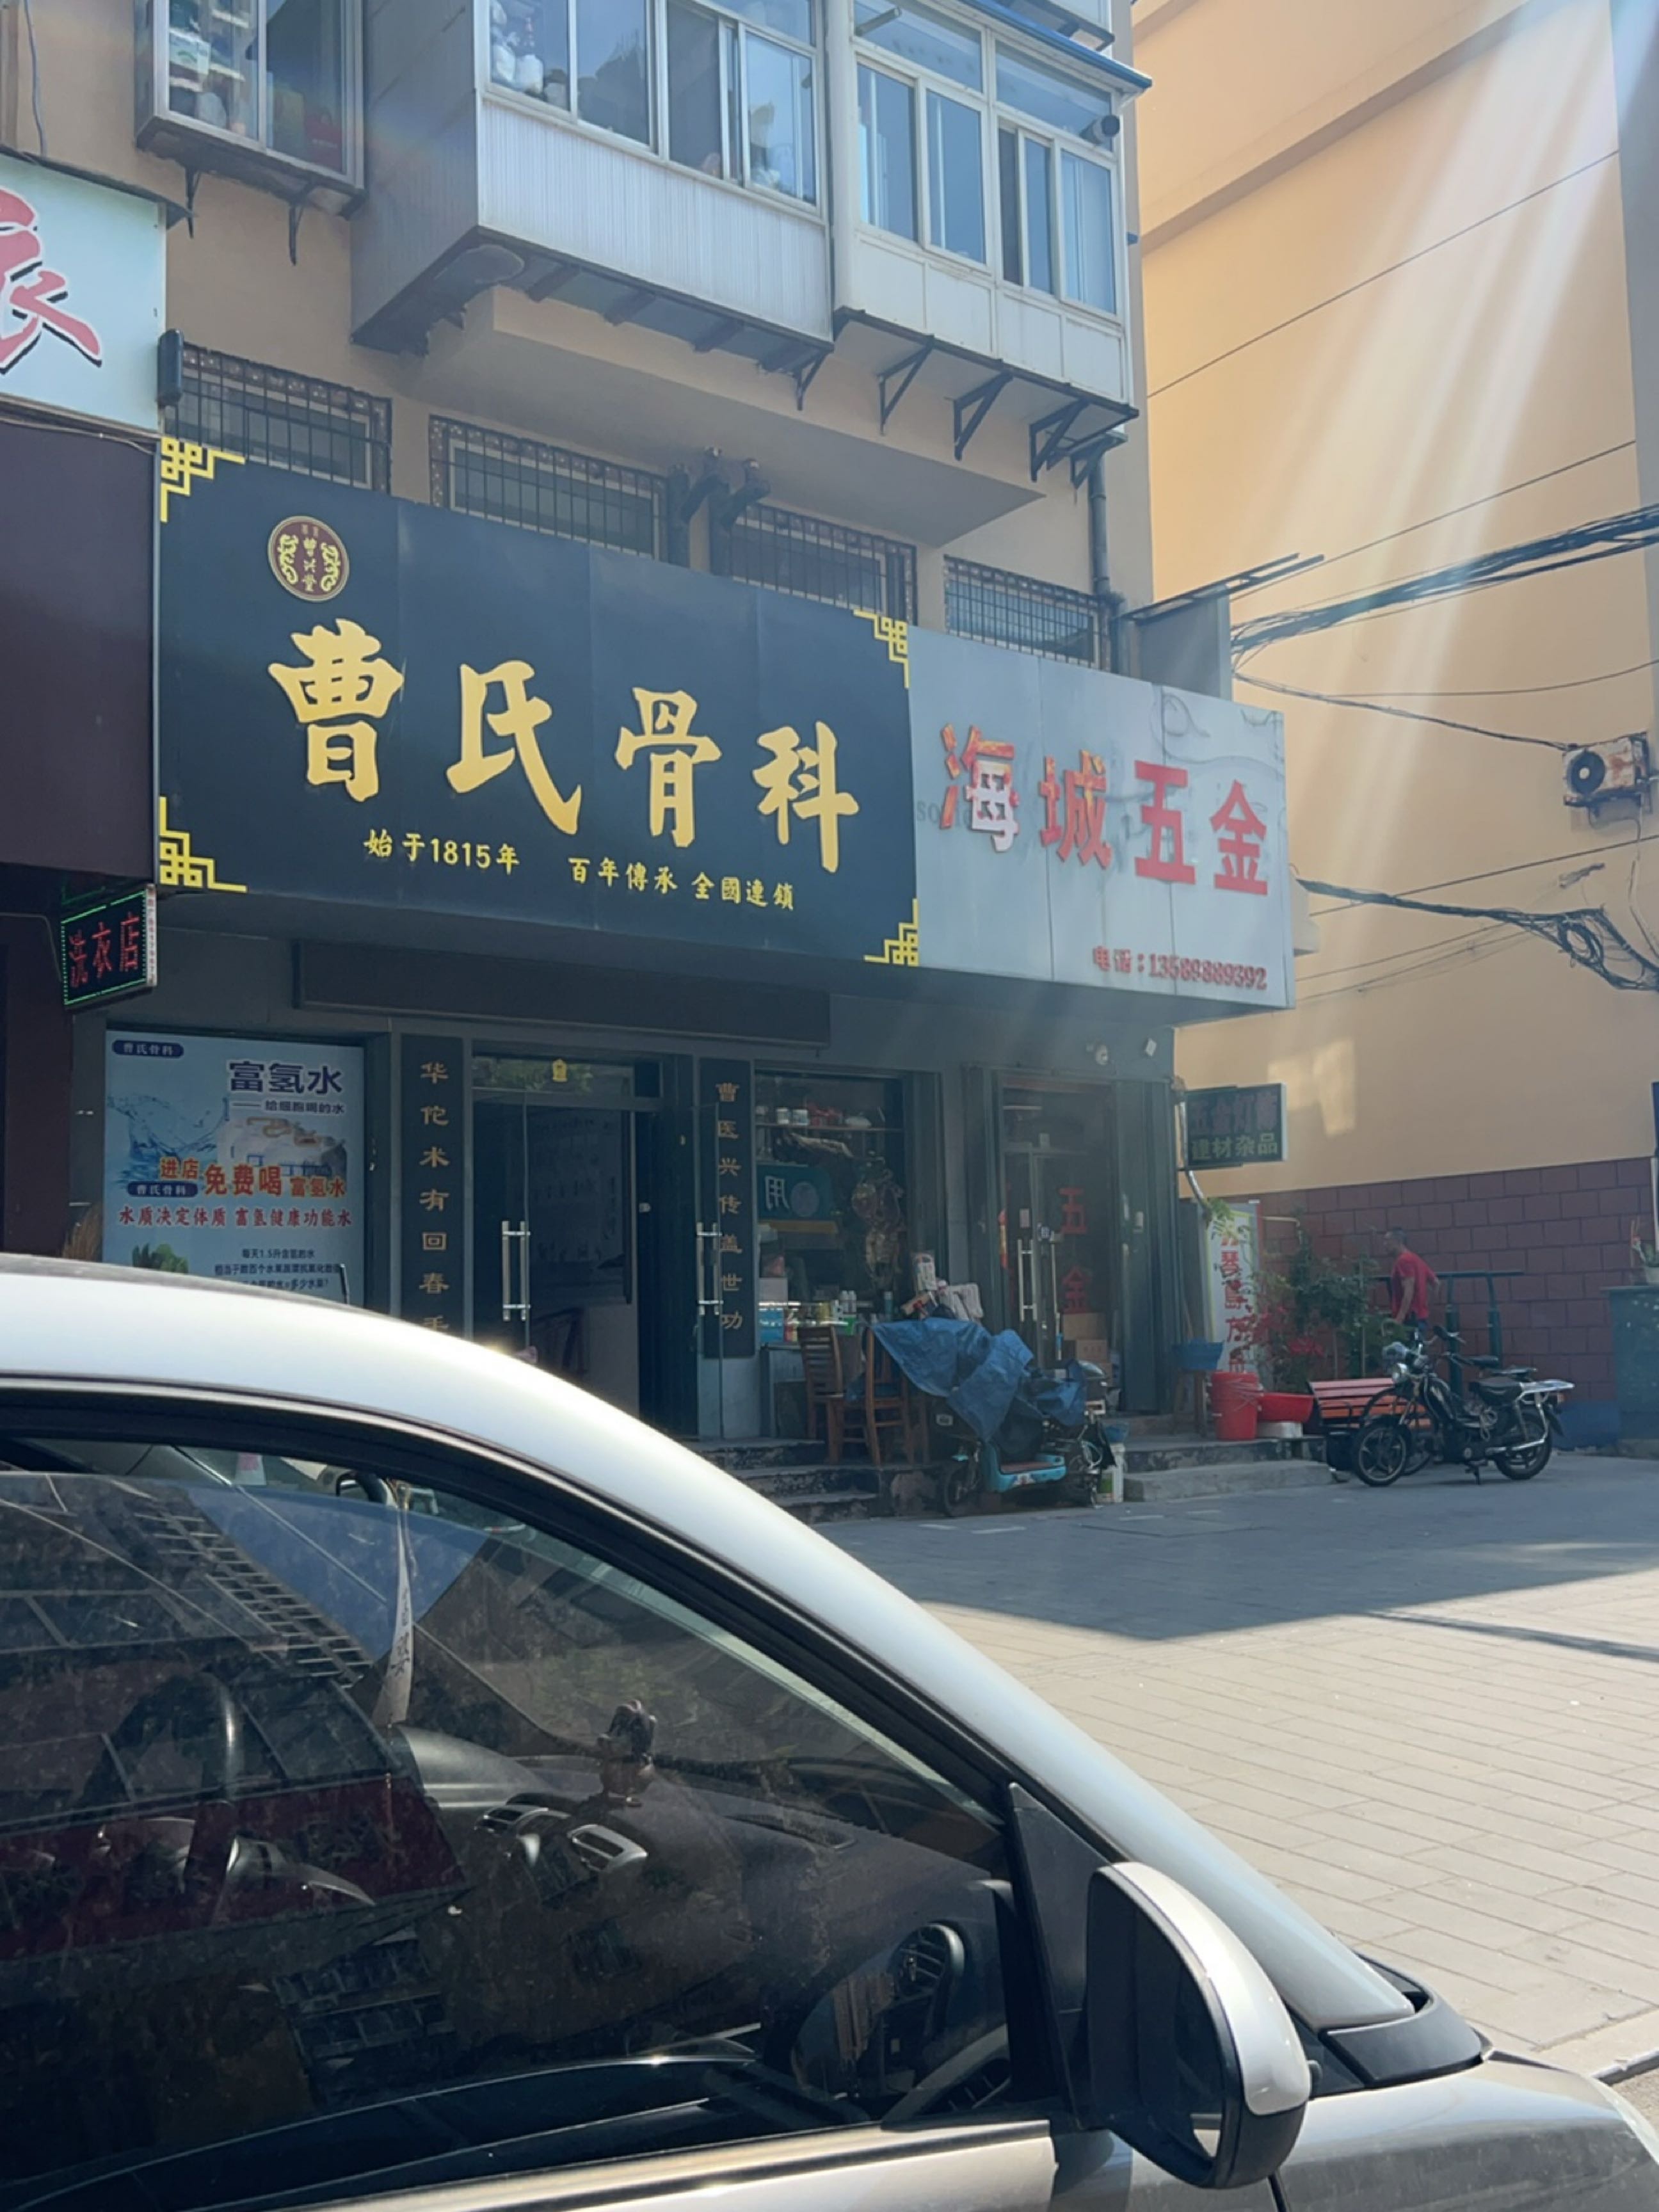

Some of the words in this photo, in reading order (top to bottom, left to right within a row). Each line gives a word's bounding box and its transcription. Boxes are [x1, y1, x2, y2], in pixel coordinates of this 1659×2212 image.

[268, 618, 860, 873] 曹氏骨科
[940, 722, 1268, 896] 海城五金
[363, 830, 520, 874] 始于1815年
[229, 1060, 343, 1095] 富氢水
[161, 1158, 199, 1180] 进店
[205, 1164, 282, 1196] 免费喝
[291, 1176, 346, 1199] 富氢水
[120, 1205, 226, 1228] 水质决定体质
[236, 1207, 352, 1228] 富氢健康功能水
[1059, 1187, 1093, 1314] 五金
